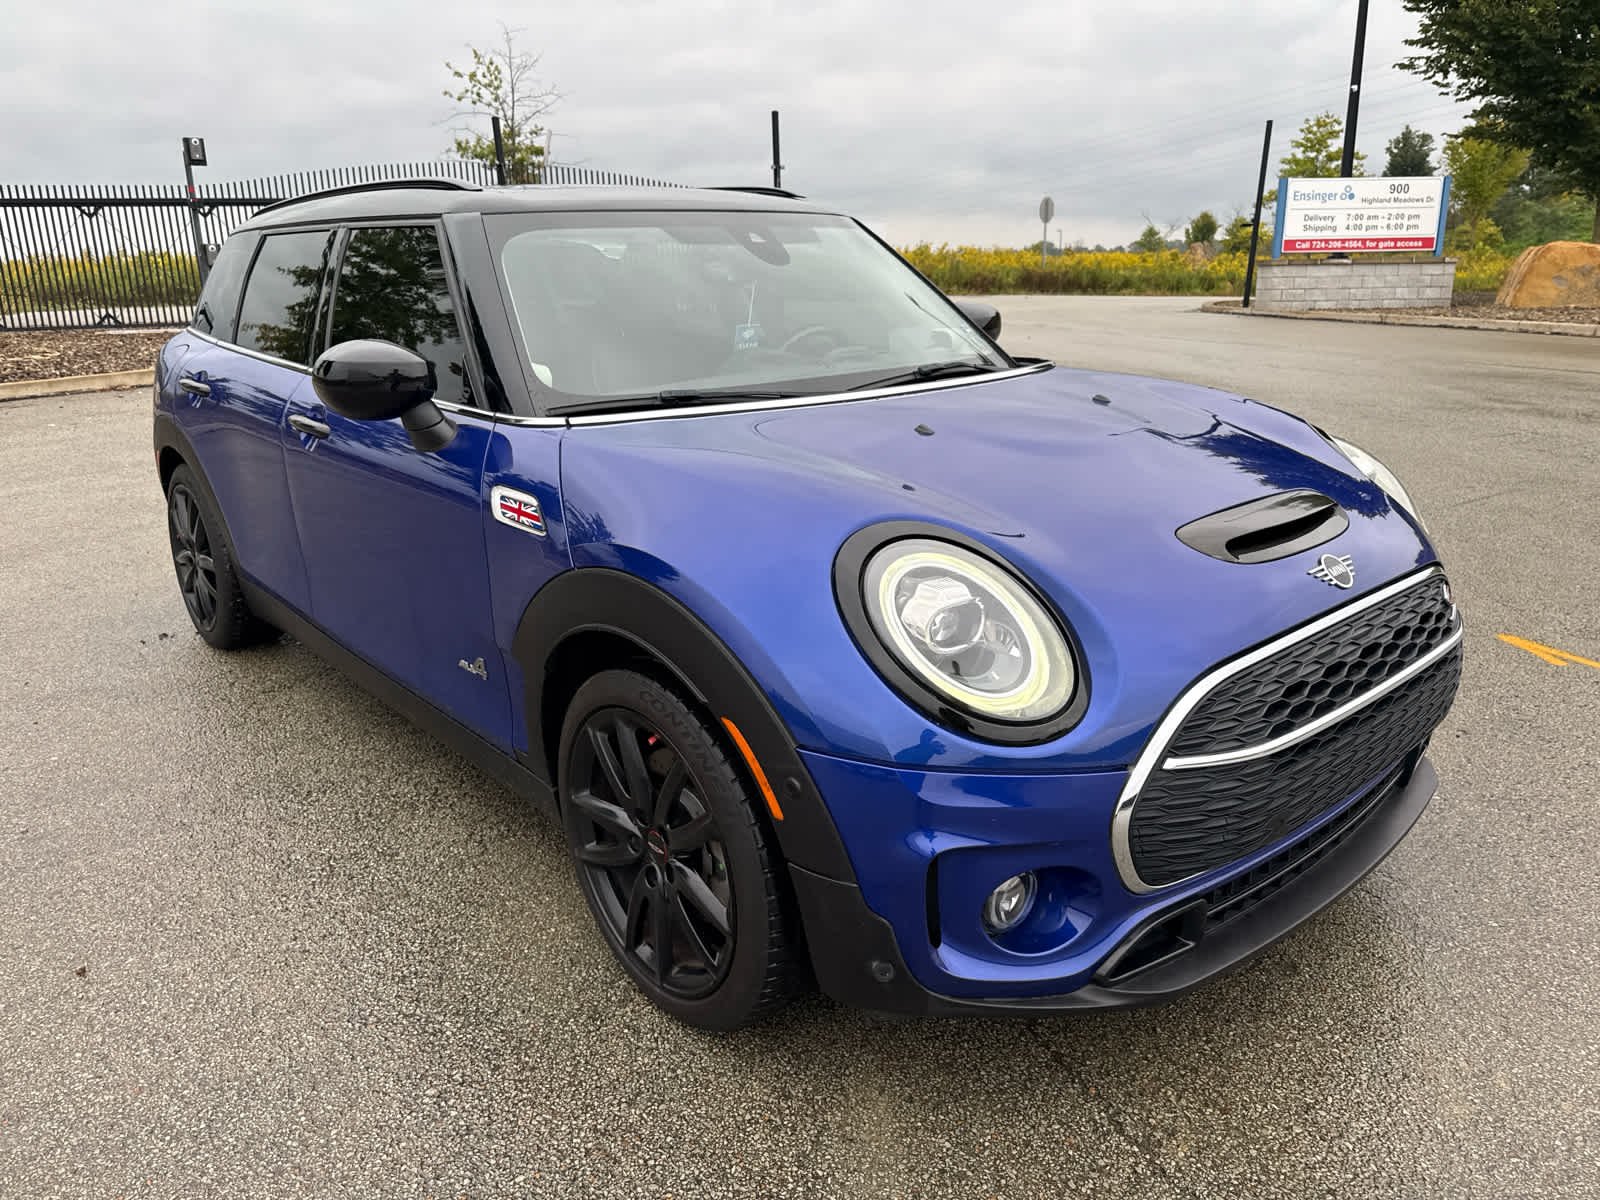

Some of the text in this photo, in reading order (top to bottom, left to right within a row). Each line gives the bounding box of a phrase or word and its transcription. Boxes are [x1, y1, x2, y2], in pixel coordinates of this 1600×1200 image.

[1389, 183, 1410, 194] 900
[1293, 191, 1337, 203] Ensinger
[1361, 197, 1391, 205] Highland
[1393, 196, 1424, 204] Meadows
[1304, 213, 1335, 223] Delivery
[1346, 213, 1364, 221] 7:00
[1387, 213, 1405, 221] 2:00
[1303, 224, 1337, 233] Shipping
[1345, 223, 1363, 231] 4:00
[1365, 224, 1378, 232] pm
[1386, 223, 1404, 231] 6:00
[1406, 224, 1419, 232] pm
[1295, 240, 1310, 249] Call
[1366, 240, 1377, 248] for
[1378, 240, 1394, 249] gate
